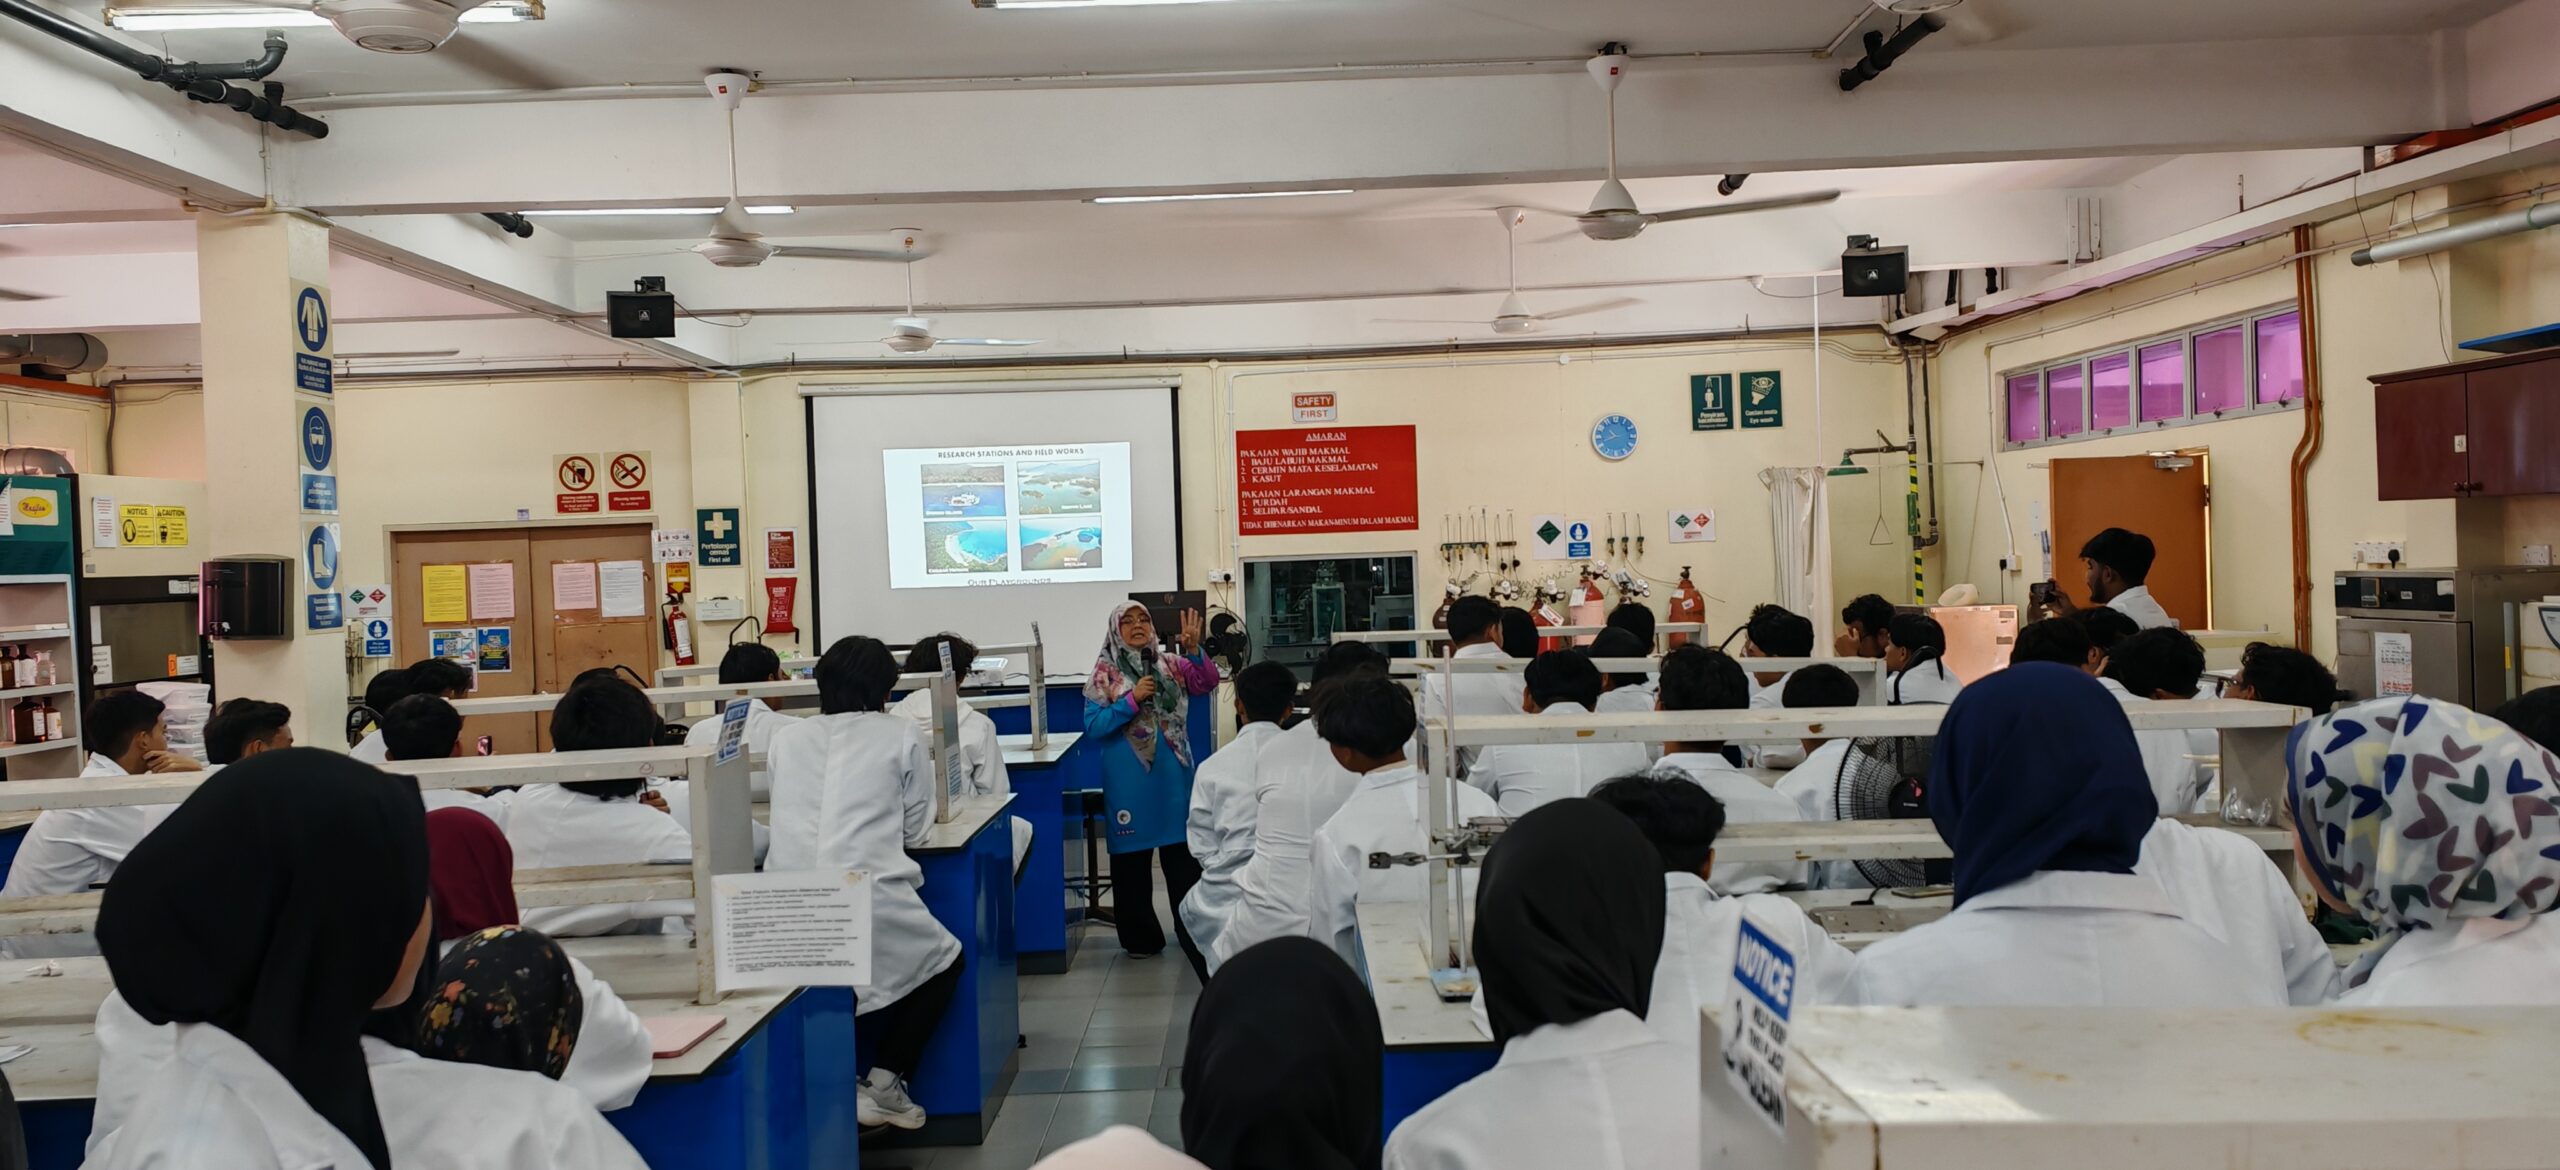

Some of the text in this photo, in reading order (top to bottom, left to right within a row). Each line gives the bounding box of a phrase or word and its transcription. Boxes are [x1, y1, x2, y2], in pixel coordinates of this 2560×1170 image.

[1296, 396, 1332, 406] SAFETY
[1300, 410, 1328, 418] FIRST
[1305, 432, 1347, 441] AMARAN
[938, 450, 975, 459] RESEARCH
[977, 449, 1014, 458] STATIONS
[1035, 448, 1053, 456] FIELD
[1055, 447, 1084, 455] WORKS
[1240, 447, 1351, 458] PAKAIAN WAJIB MAKMAL
[1251, 458, 1273, 466] BAJU
[1275, 457, 1305, 465] LABUH
[1306, 455, 1348, 464] MAKMAL
[1251, 466, 1286, 474] CERMIN
[1288, 465, 1313, 473] MATA
[1314, 463, 1379, 472] KESELAMATAN
[1252, 474, 1281, 483] KASUT
[1241, 486, 1375, 499] PAKAIAN LARANGAN MAKMAL
[1253, 498, 1288, 507] PURDAH
[127, 508, 148, 516] NOTICE
[162, 509, 185, 517] CAUTION
[1242, 521, 1263, 529] TIDAK
[1263, 519, 1307, 528] DIBENARKAN
[1359, 517, 1383, 526] DALAM
[1384, 515, 1416, 525] MAKMAL
[1738, 930, 1794, 1005] NOTICE
